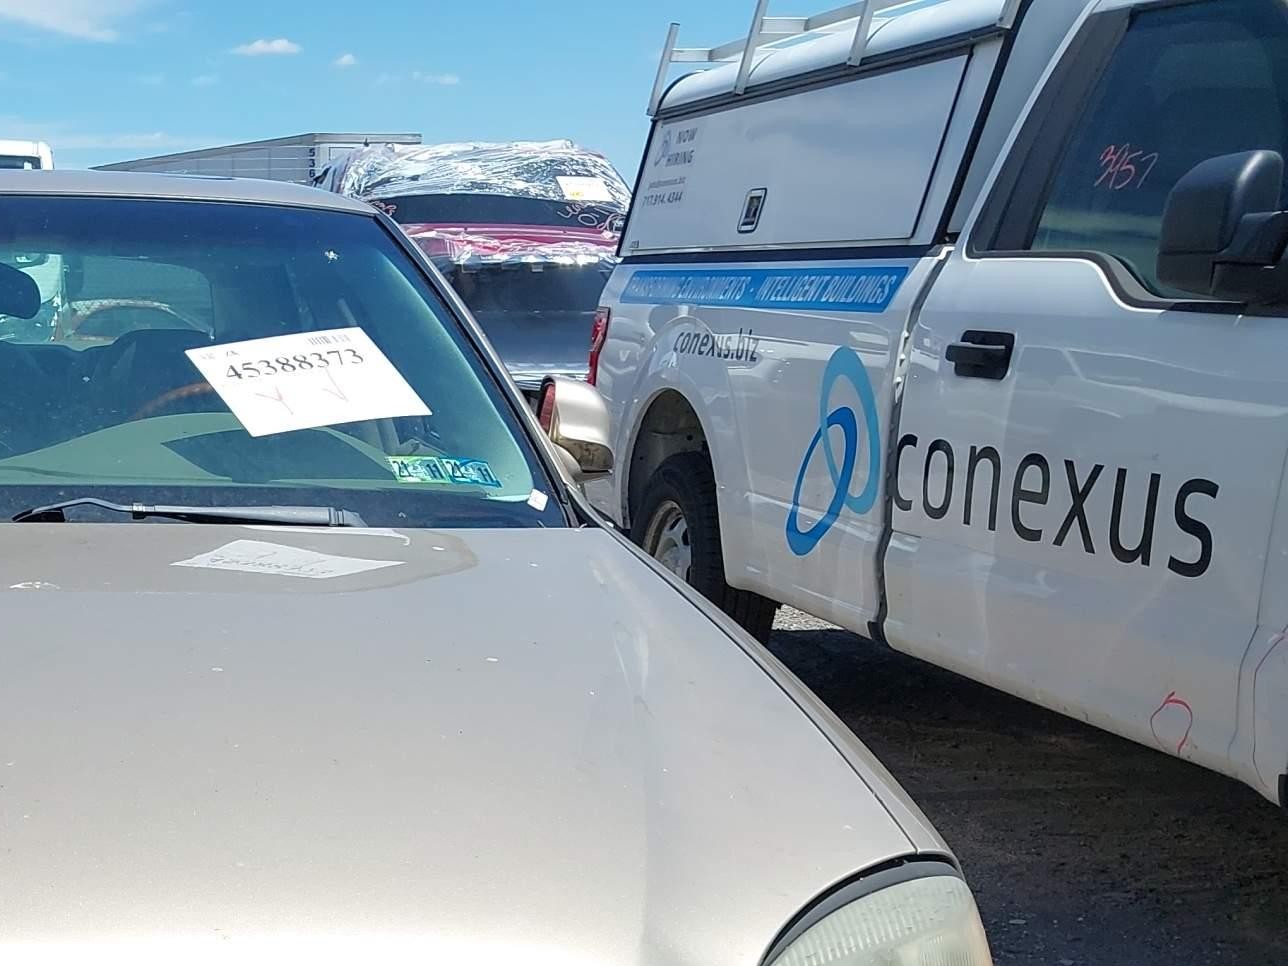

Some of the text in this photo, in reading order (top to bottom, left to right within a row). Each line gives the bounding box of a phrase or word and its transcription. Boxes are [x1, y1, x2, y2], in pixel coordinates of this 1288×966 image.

[675, 128, 697, 144] NOW
[665, 150, 694, 167] HIRING
[756, 274, 896, 304] INTELLIGENT BUILDINGS
[673, 328, 760, 362] conexus.biz
[226, 348, 364, 380] 45388373
[893, 433, 1220, 578] conexus
